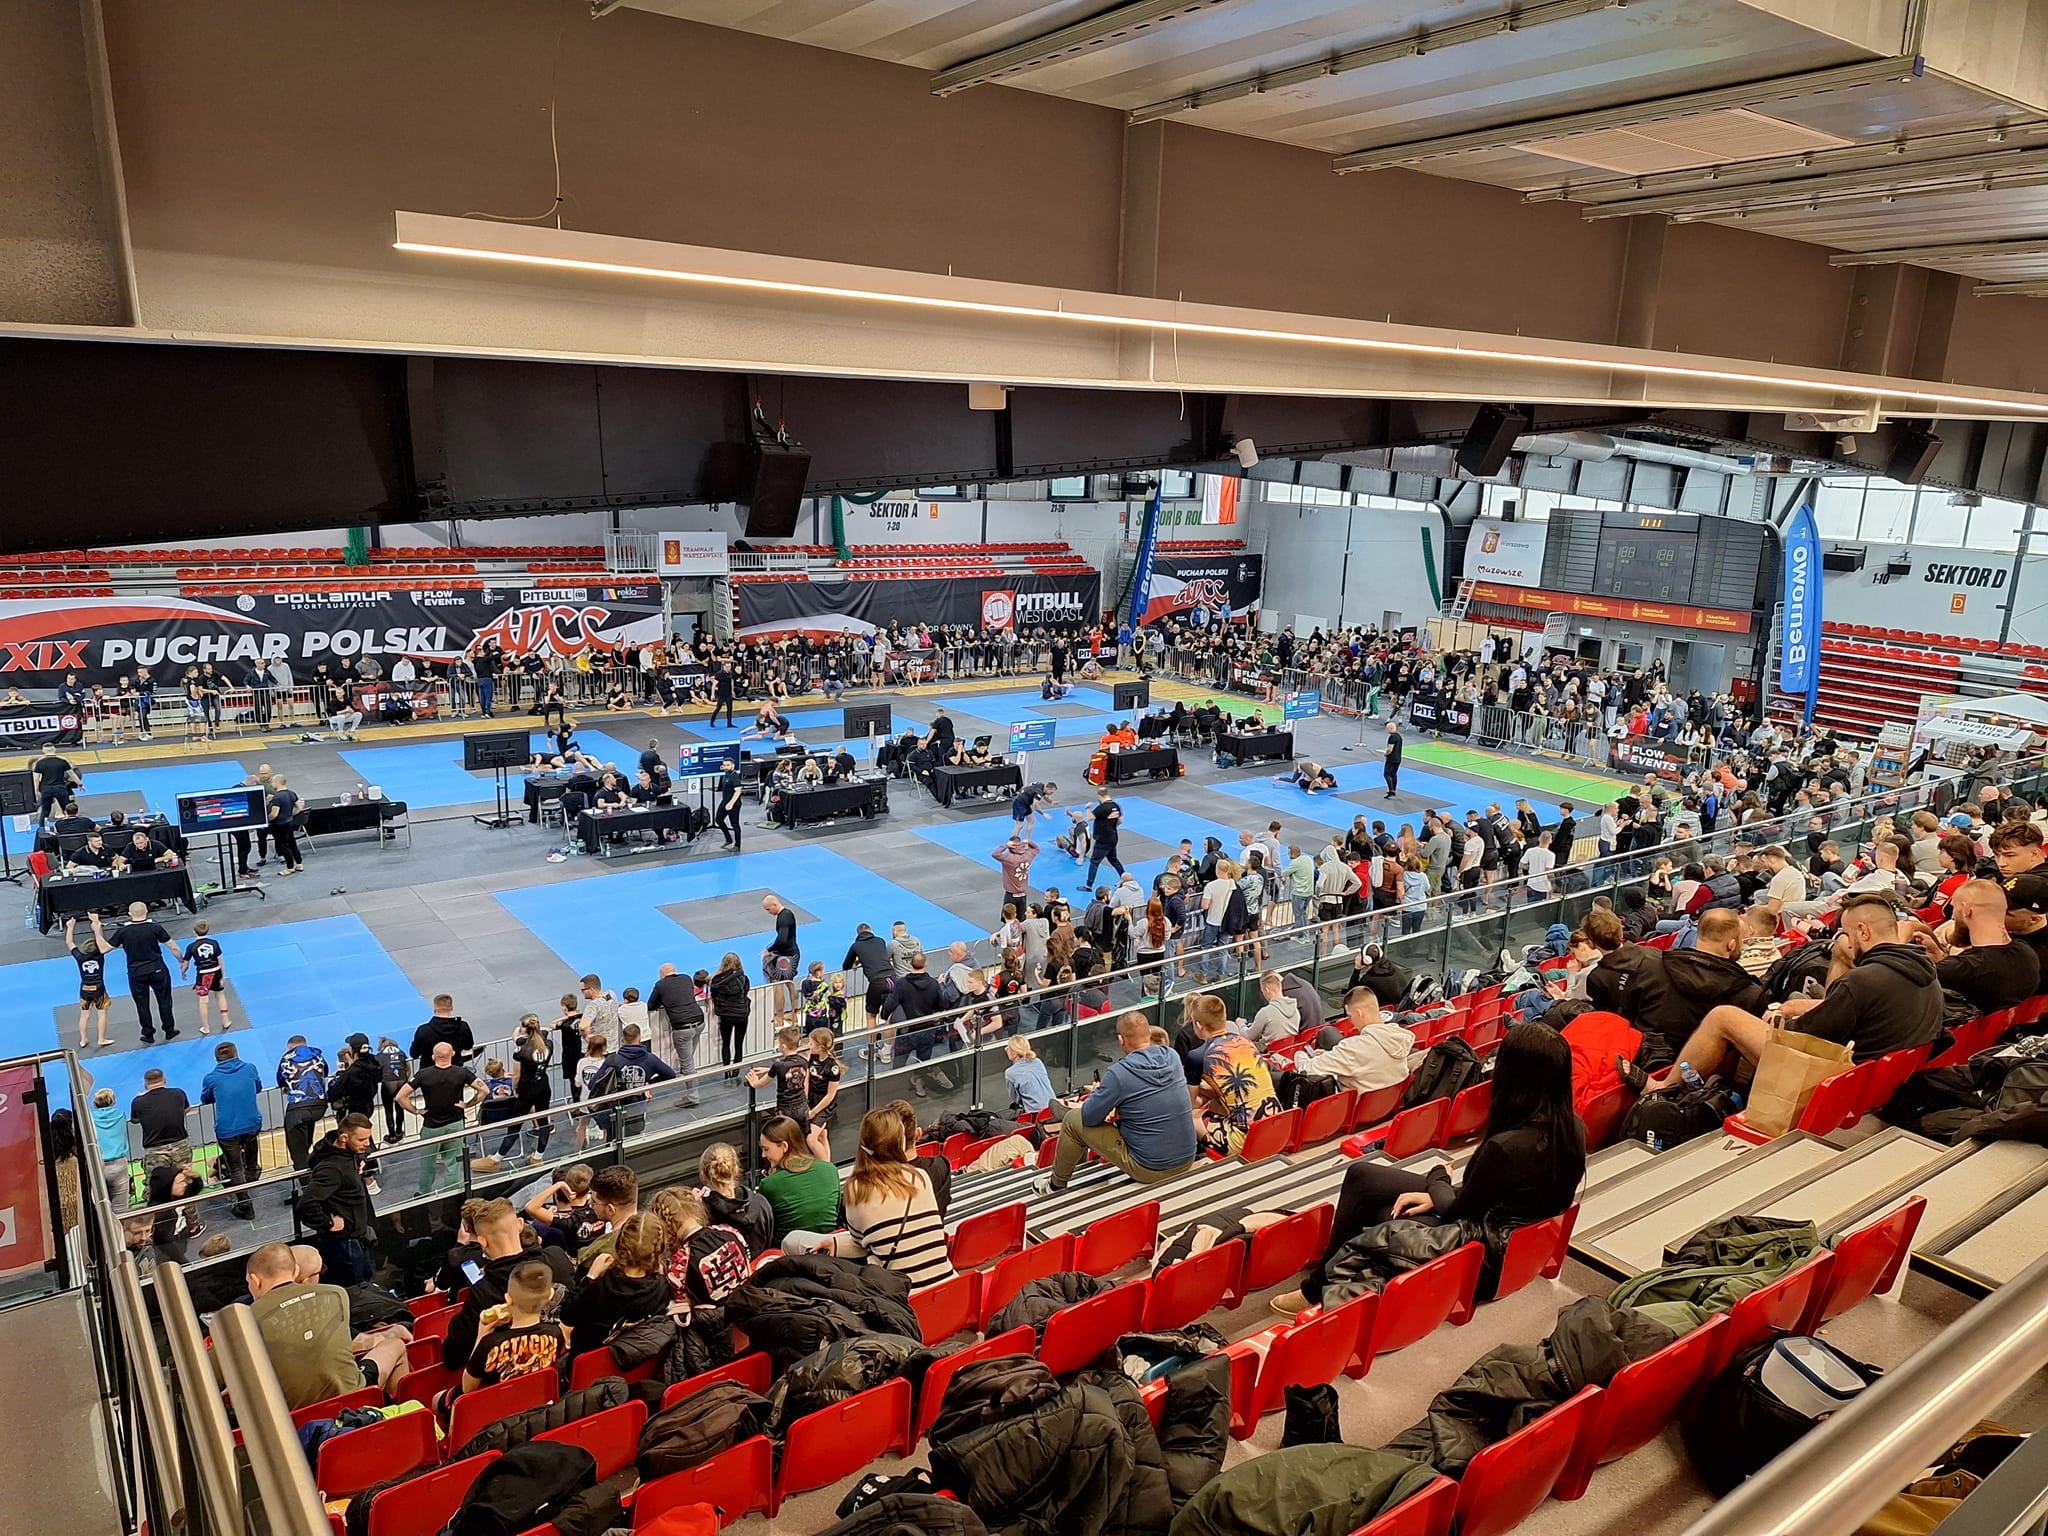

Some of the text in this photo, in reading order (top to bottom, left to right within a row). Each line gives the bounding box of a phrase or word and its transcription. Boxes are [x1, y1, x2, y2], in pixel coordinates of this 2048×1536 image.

[869, 502, 918, 518] SEKTOR A
[1174, 510, 1182, 526] B
[887, 521, 901, 531] 7-20
[1141, 509, 1159, 596] Bemowo
[1177, 568, 1229, 577] PUCHAR POLSKI
[1924, 563, 2008, 588] SEKTOR D
[1872, 573, 1890, 585] 1-10
[424, 590, 453, 598] FLOW
[522, 590, 572, 601] PITBULL
[327, 601, 376, 609] SURFACES
[424, 597, 466, 606] EVENTS
[1016, 591, 1083, 610] PITBULL
[1953, 598, 1963, 609] D
[1, 626, 447, 672] XIX PUCHAR POLSKI
[1241, 677, 1267, 688] EVENTS
[683, 748, 690, 757] 0
[1632, 745, 1665, 760] FLOW
[682, 758, 689, 767] 0
[1630, 754, 1677, 772] EVENTS
[691, 782, 697, 791] 6
